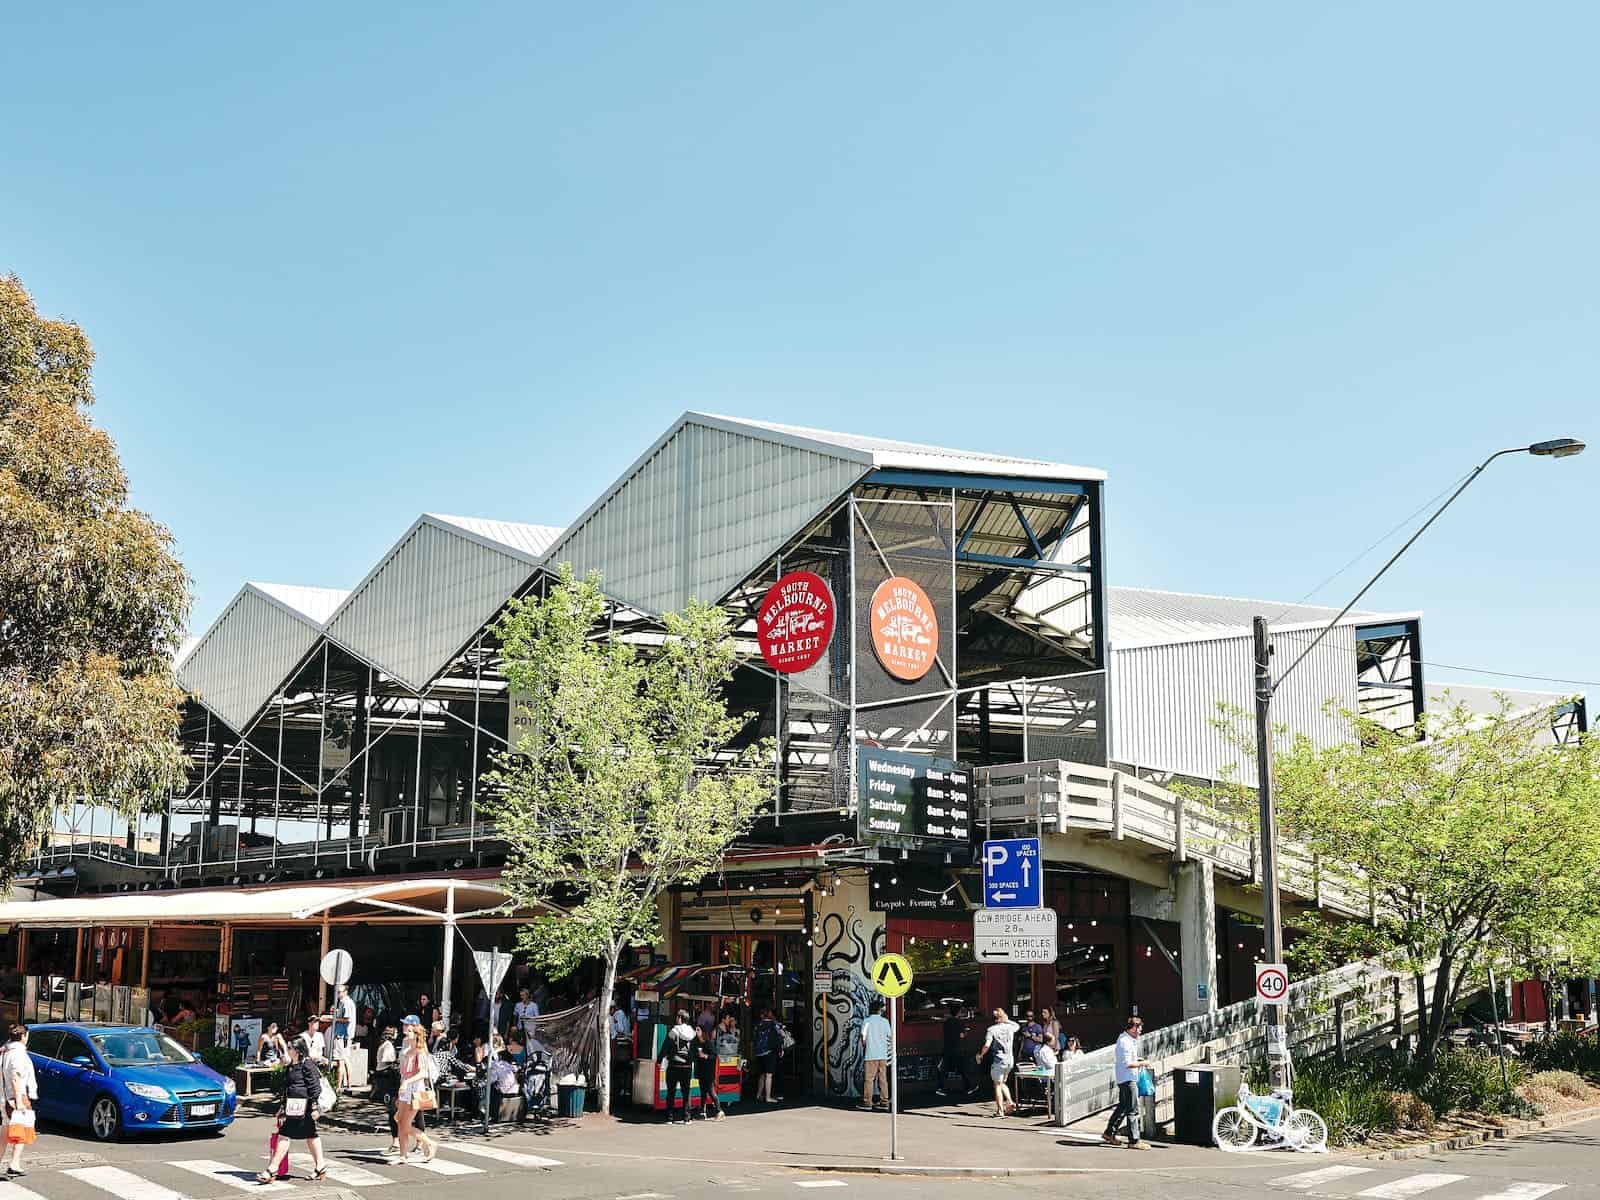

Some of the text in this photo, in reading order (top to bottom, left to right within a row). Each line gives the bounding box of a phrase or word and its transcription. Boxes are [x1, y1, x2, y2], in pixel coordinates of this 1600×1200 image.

[780, 581, 810, 597] SOUTH
[892, 587, 918, 603] SOUTH
[763, 591, 828, 626] MELBOURNE
[877, 597, 934, 633] MELBOURNE
[770, 636, 820, 656] MARKET
[884, 641, 928, 663] MARKET
[869, 760, 915, 779] Wednesday
[926, 768, 943, 781] 8am
[950, 772, 967, 785] 4pm
[869, 779, 896, 795] Friday
[926, 786, 944, 799] 8am
[950, 789, 967, 803] 5pm
[869, 798, 907, 815] Saturday
[927, 804, 944, 817] 8am
[950, 807, 968, 821] 4pm
[869, 817, 901, 833] Sunday
[927, 823, 945, 835] 8am
[950, 825, 968, 839] 4pm
[987, 846, 1008, 877] P
[1015, 849, 1037, 857] SPACES
[999, 880, 1019, 889] SPACES
[909, 899, 937, 909] Evening
[939, 898, 955, 906] Star
[976, 913, 1053, 923] LOW BRIDGE AHEAD
[991, 939, 1051, 948] HIGH VEHICLES
[1014, 950, 1049, 959] DETOUR
[1261, 977, 1283, 992] 40
